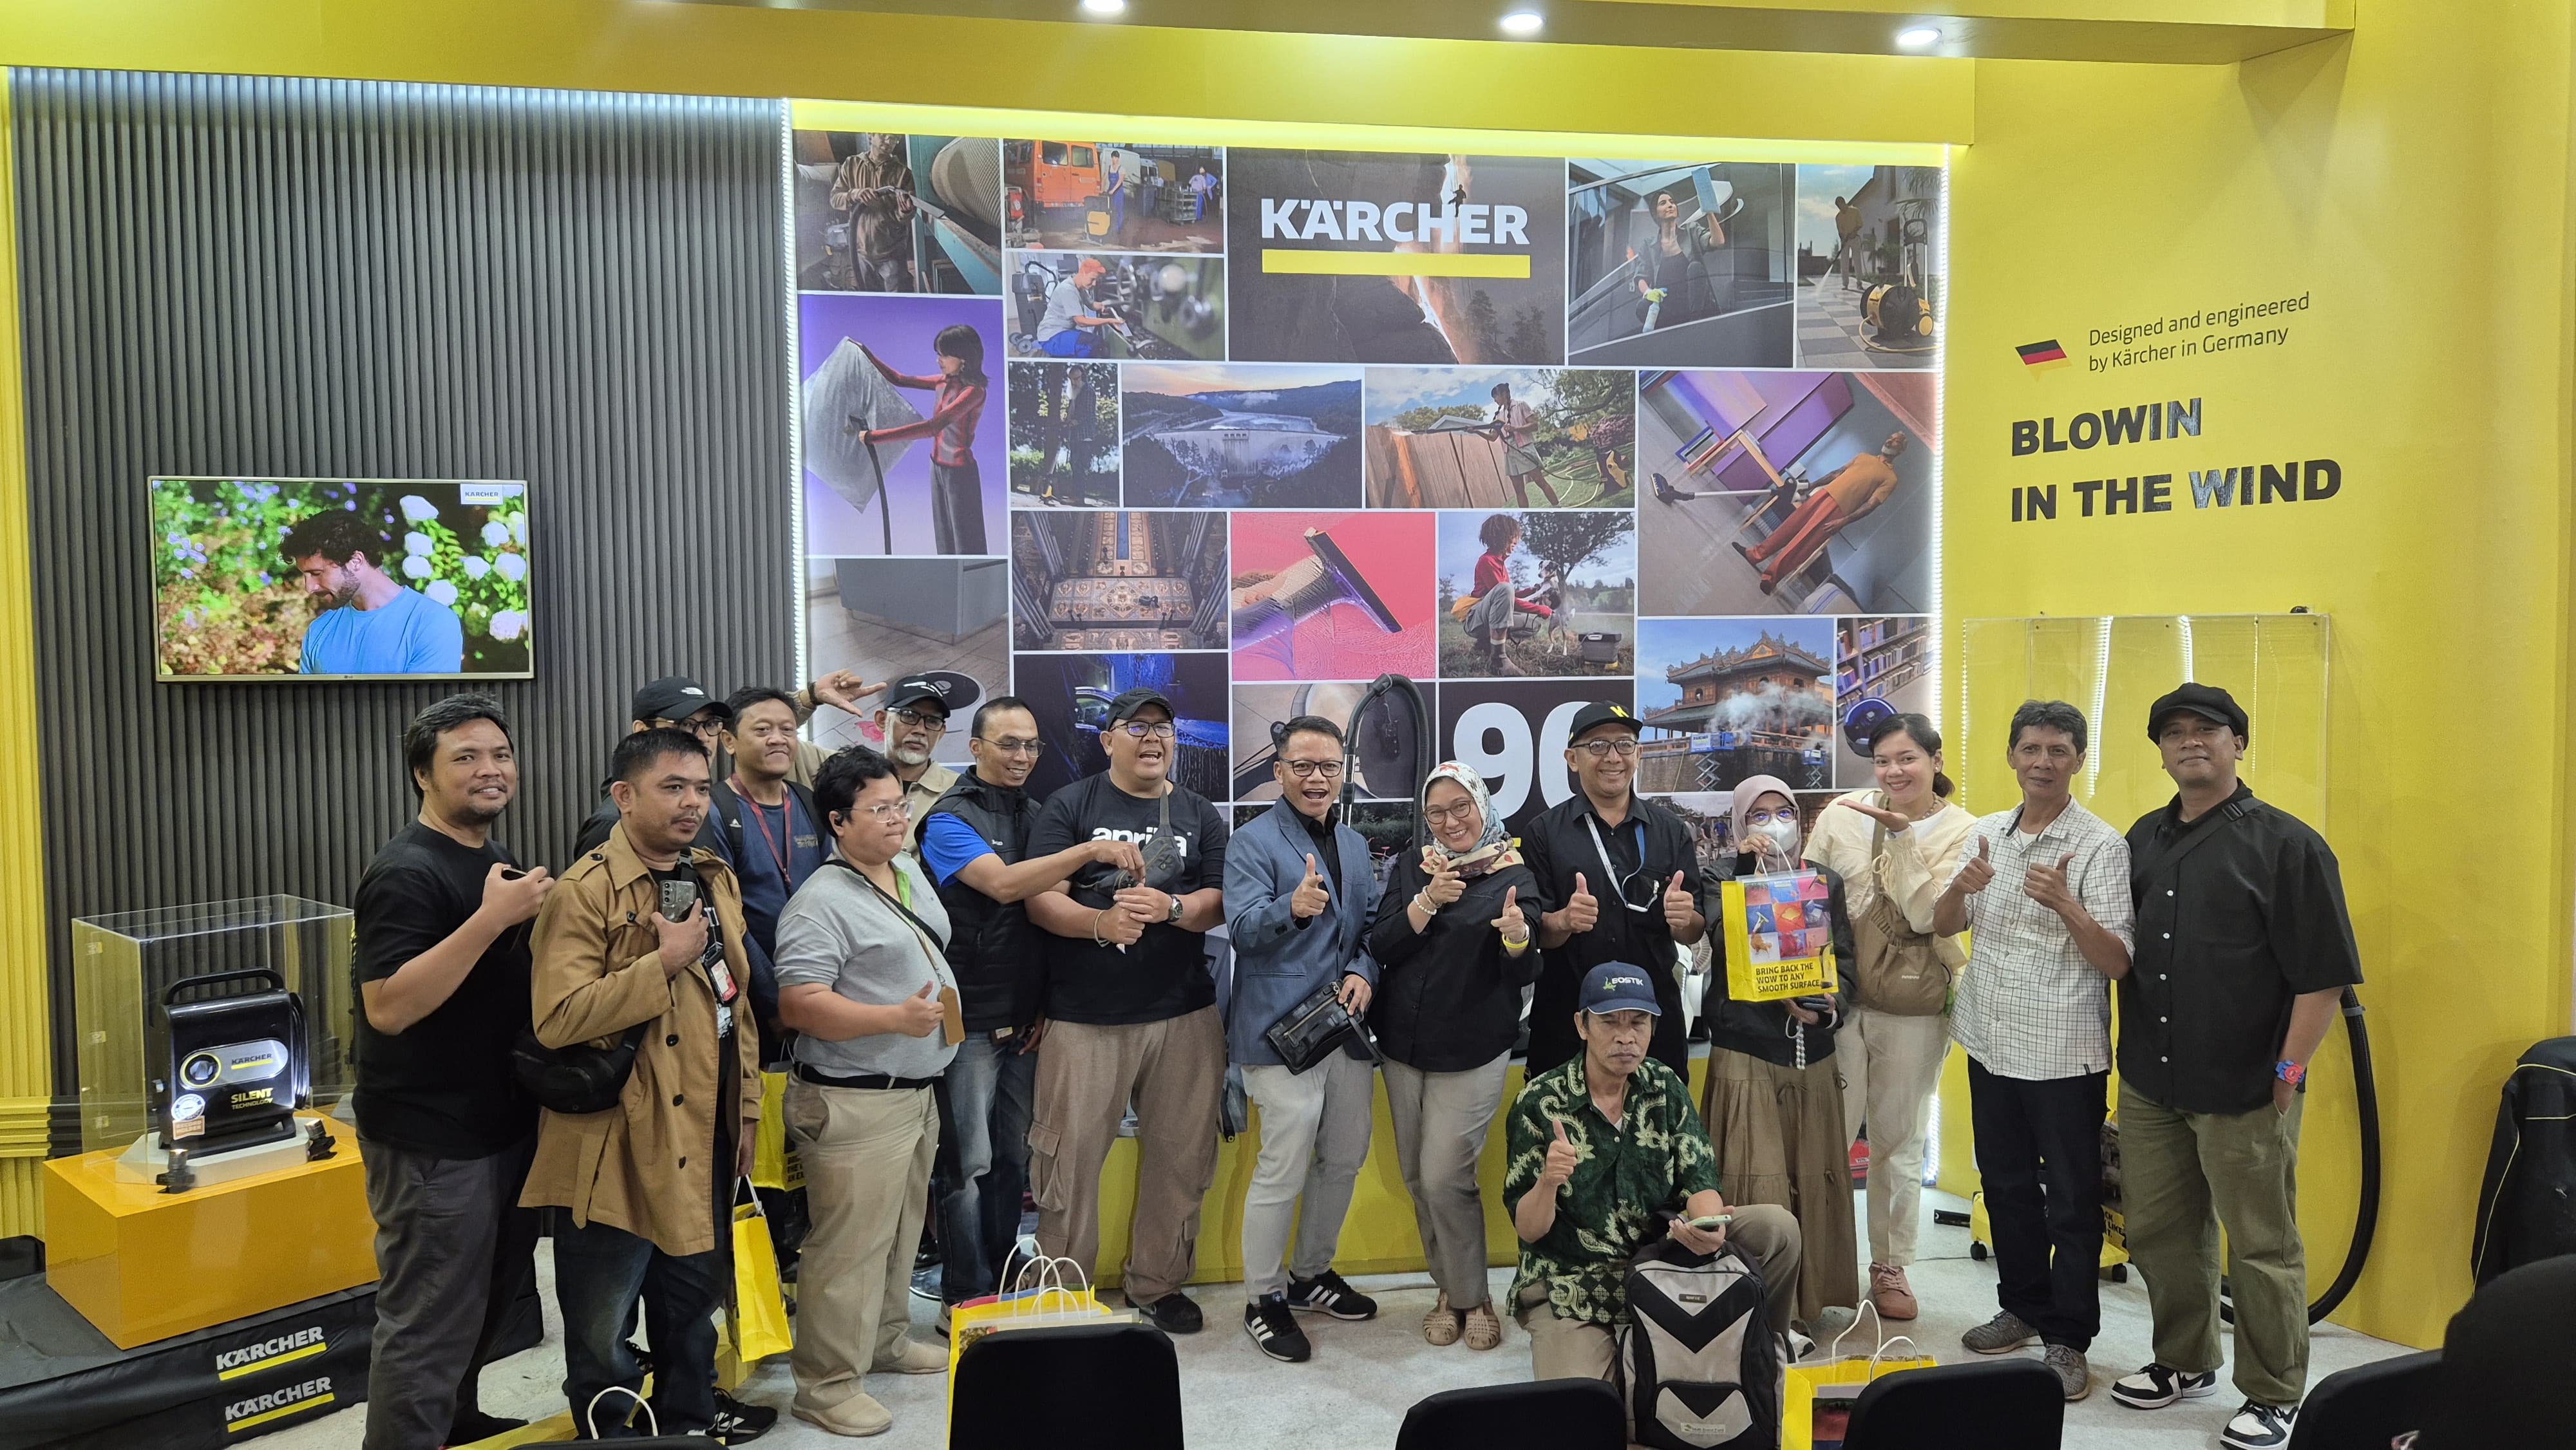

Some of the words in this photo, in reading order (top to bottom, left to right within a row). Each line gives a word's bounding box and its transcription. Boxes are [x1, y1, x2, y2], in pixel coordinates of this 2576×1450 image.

[1262, 198, 1530, 244] KÄRCHER
[2090, 317, 2163, 346] Designed
[2168, 310, 2201, 332] and
[2206, 291, 2309, 327] engineered
[2090, 355, 2108, 372] by
[2113, 344, 2176, 368] Kärcher
[2182, 339, 2197, 357] in
[2203, 328, 2289, 353] Germany
[2012, 397, 2201, 457] BLOWIN
[2012, 485, 2056, 522] IN
[2073, 473, 2172, 517] THE
[2188, 458, 2342, 509] WIND
[1091, 827, 1187, 857] apria
[1612, 977, 1643, 986] BOSTIK
[1756, 966, 1779, 975] BRING
[1781, 965, 1799, 973] BACK
[1756, 975, 1777, 984] WOW
[1790, 972, 1804, 981] ANY
[1757, 984, 1788, 993] SMOOTH
[231, 1088, 273, 1104] SILENT
[232, 1098, 273, 1110] TECHNOLOGY
[216, 1326, 324, 1370] KÄRCHER
[225, 1377, 332, 1421] KÄRCHER
